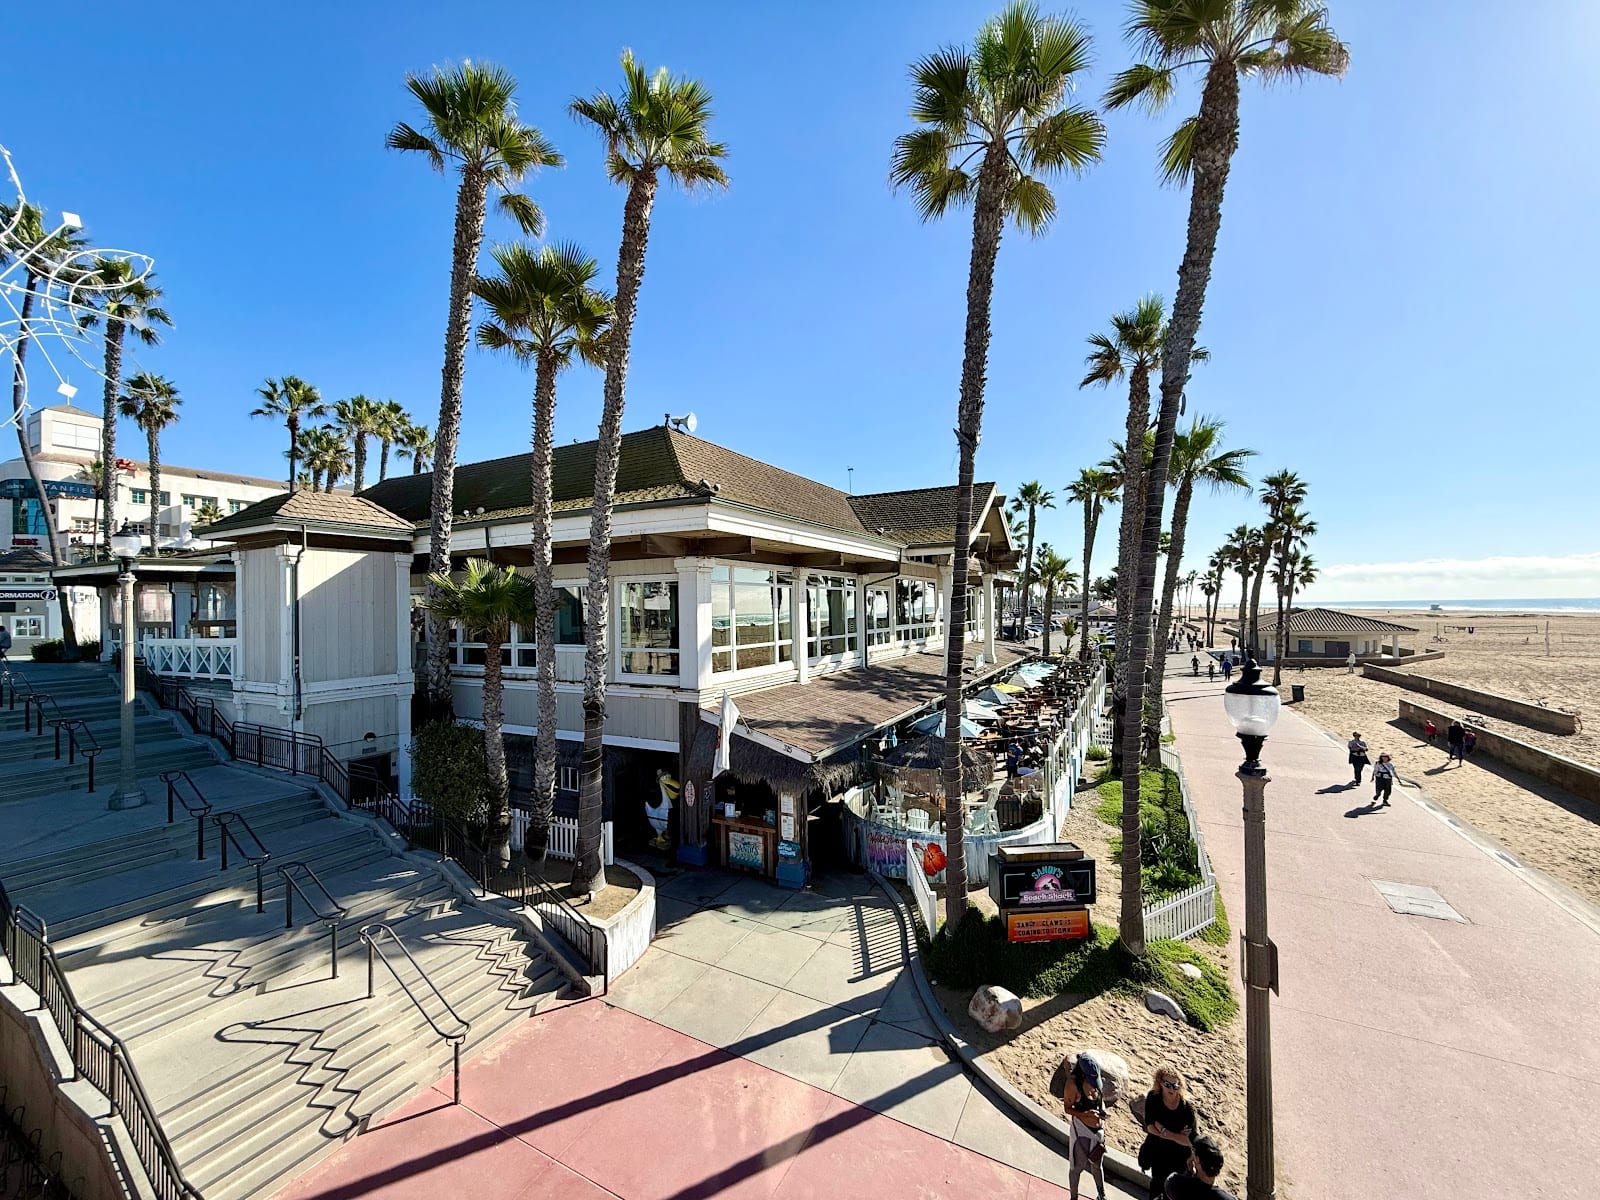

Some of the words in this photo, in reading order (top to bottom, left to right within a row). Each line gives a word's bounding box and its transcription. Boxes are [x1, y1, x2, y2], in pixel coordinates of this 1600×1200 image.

[42, 483, 102, 495] TANFIEL
[1031, 865, 1064, 880] SANDY'S
[1017, 929, 1041, 937] COMING
[1053, 927, 1072, 935] TOWN
